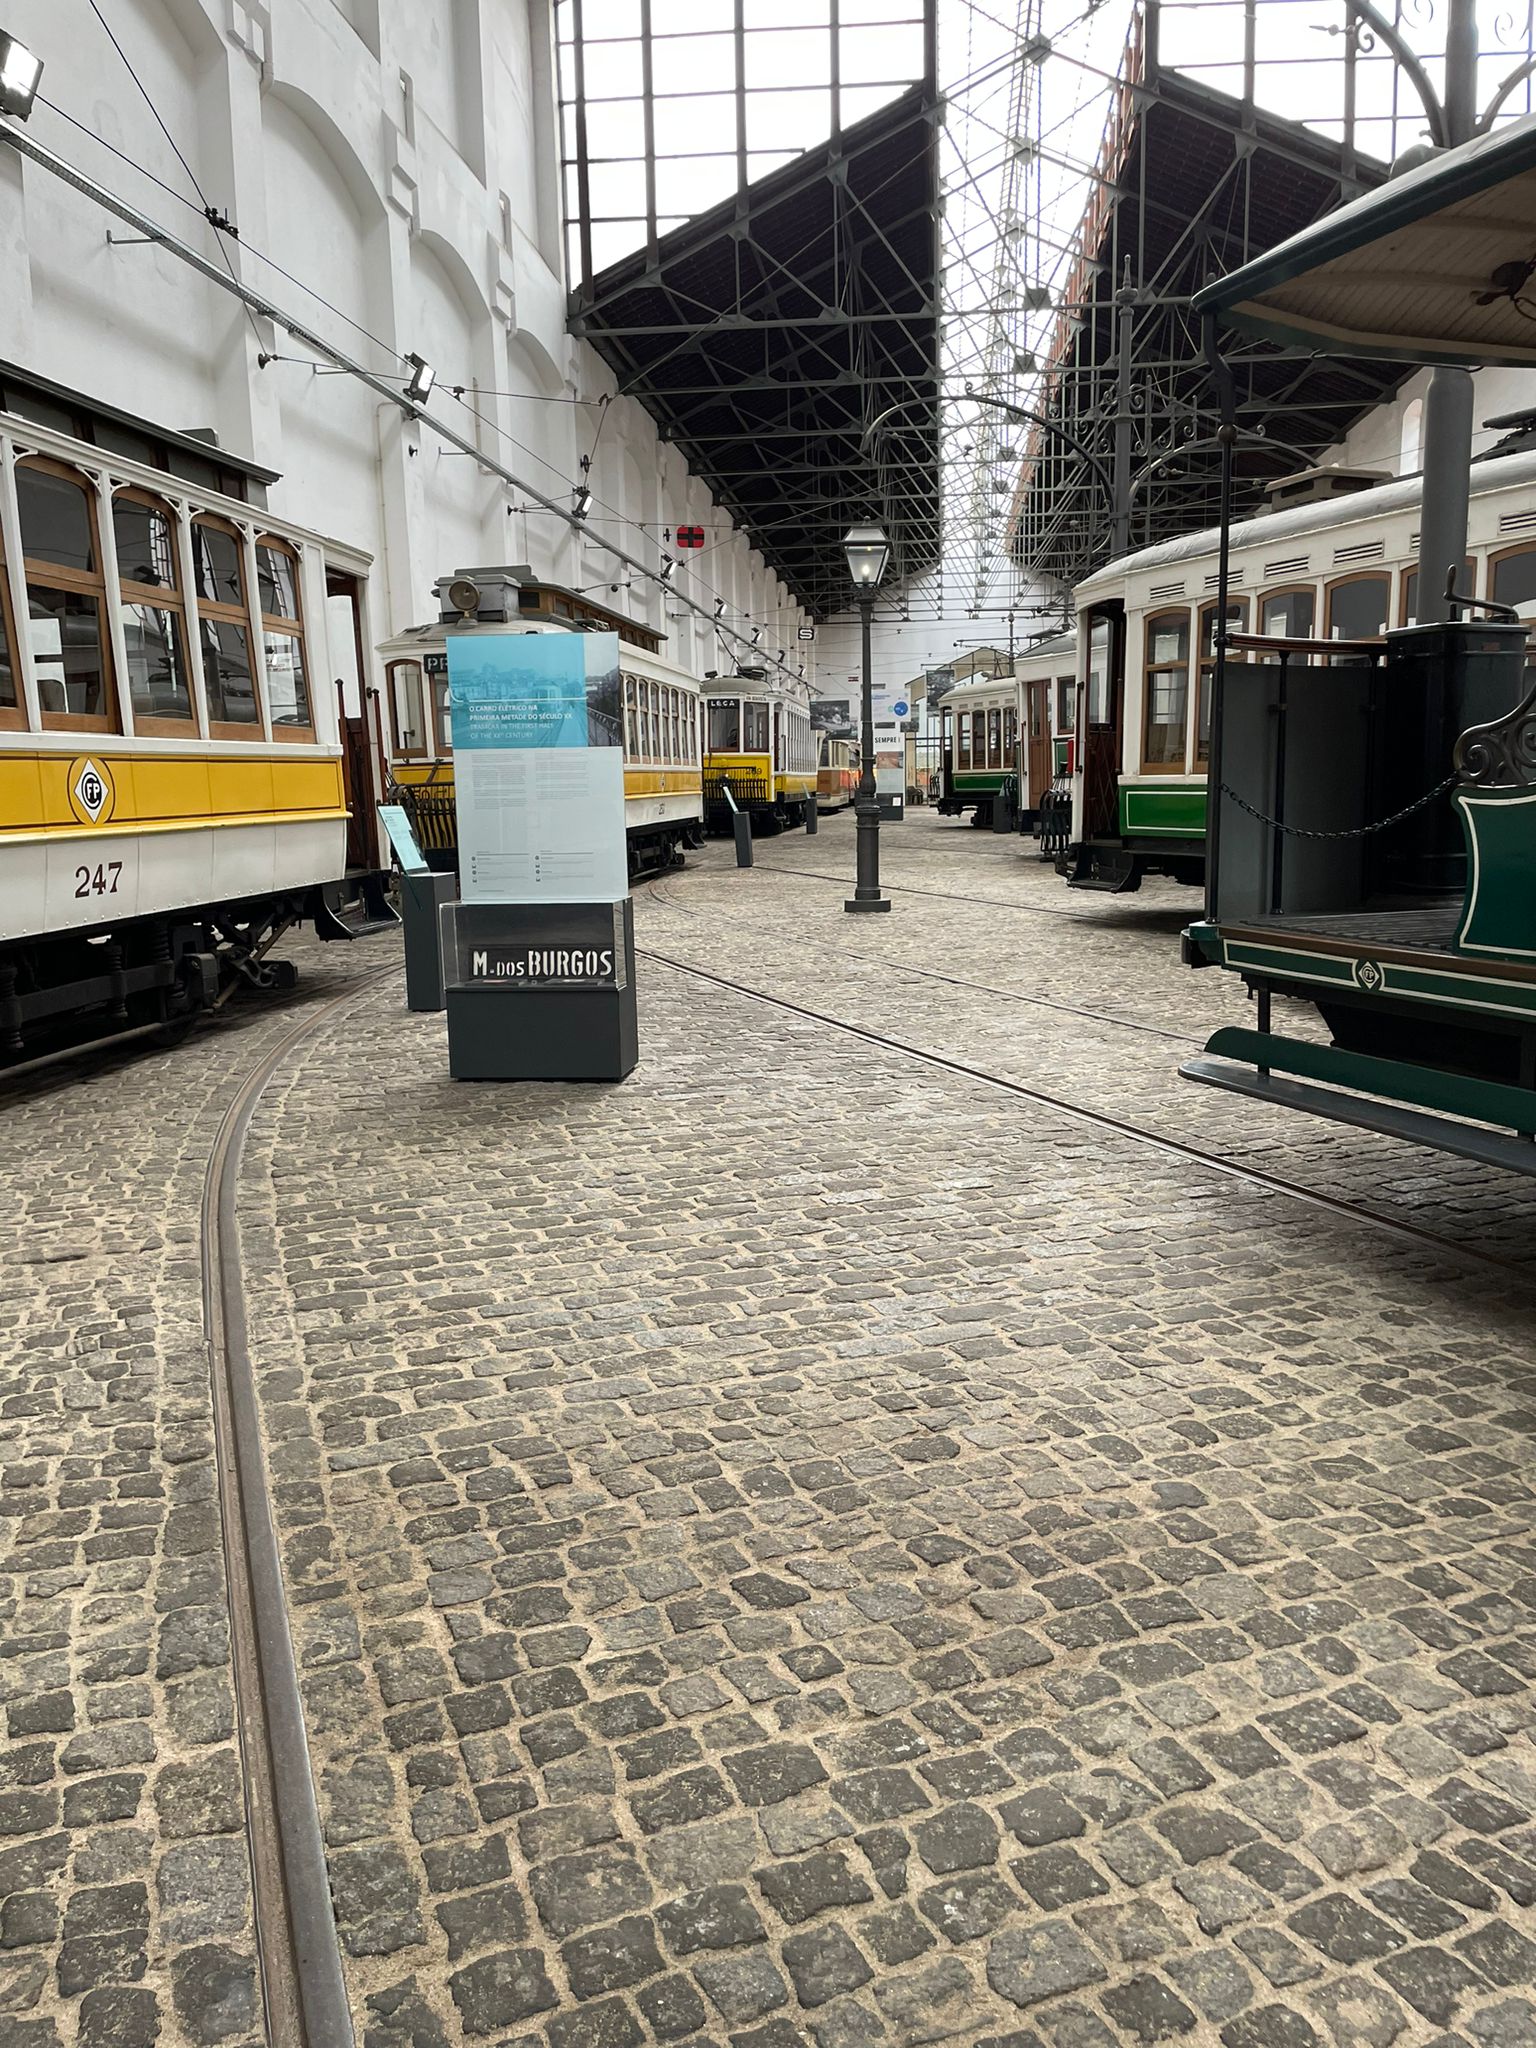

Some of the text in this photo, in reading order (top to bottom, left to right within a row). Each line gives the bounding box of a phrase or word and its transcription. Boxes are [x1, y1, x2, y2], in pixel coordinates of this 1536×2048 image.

[874, 736, 897, 744] SEMPRE
[75, 861, 122, 898] 247
[528, 950, 612, 977] BURGOS
